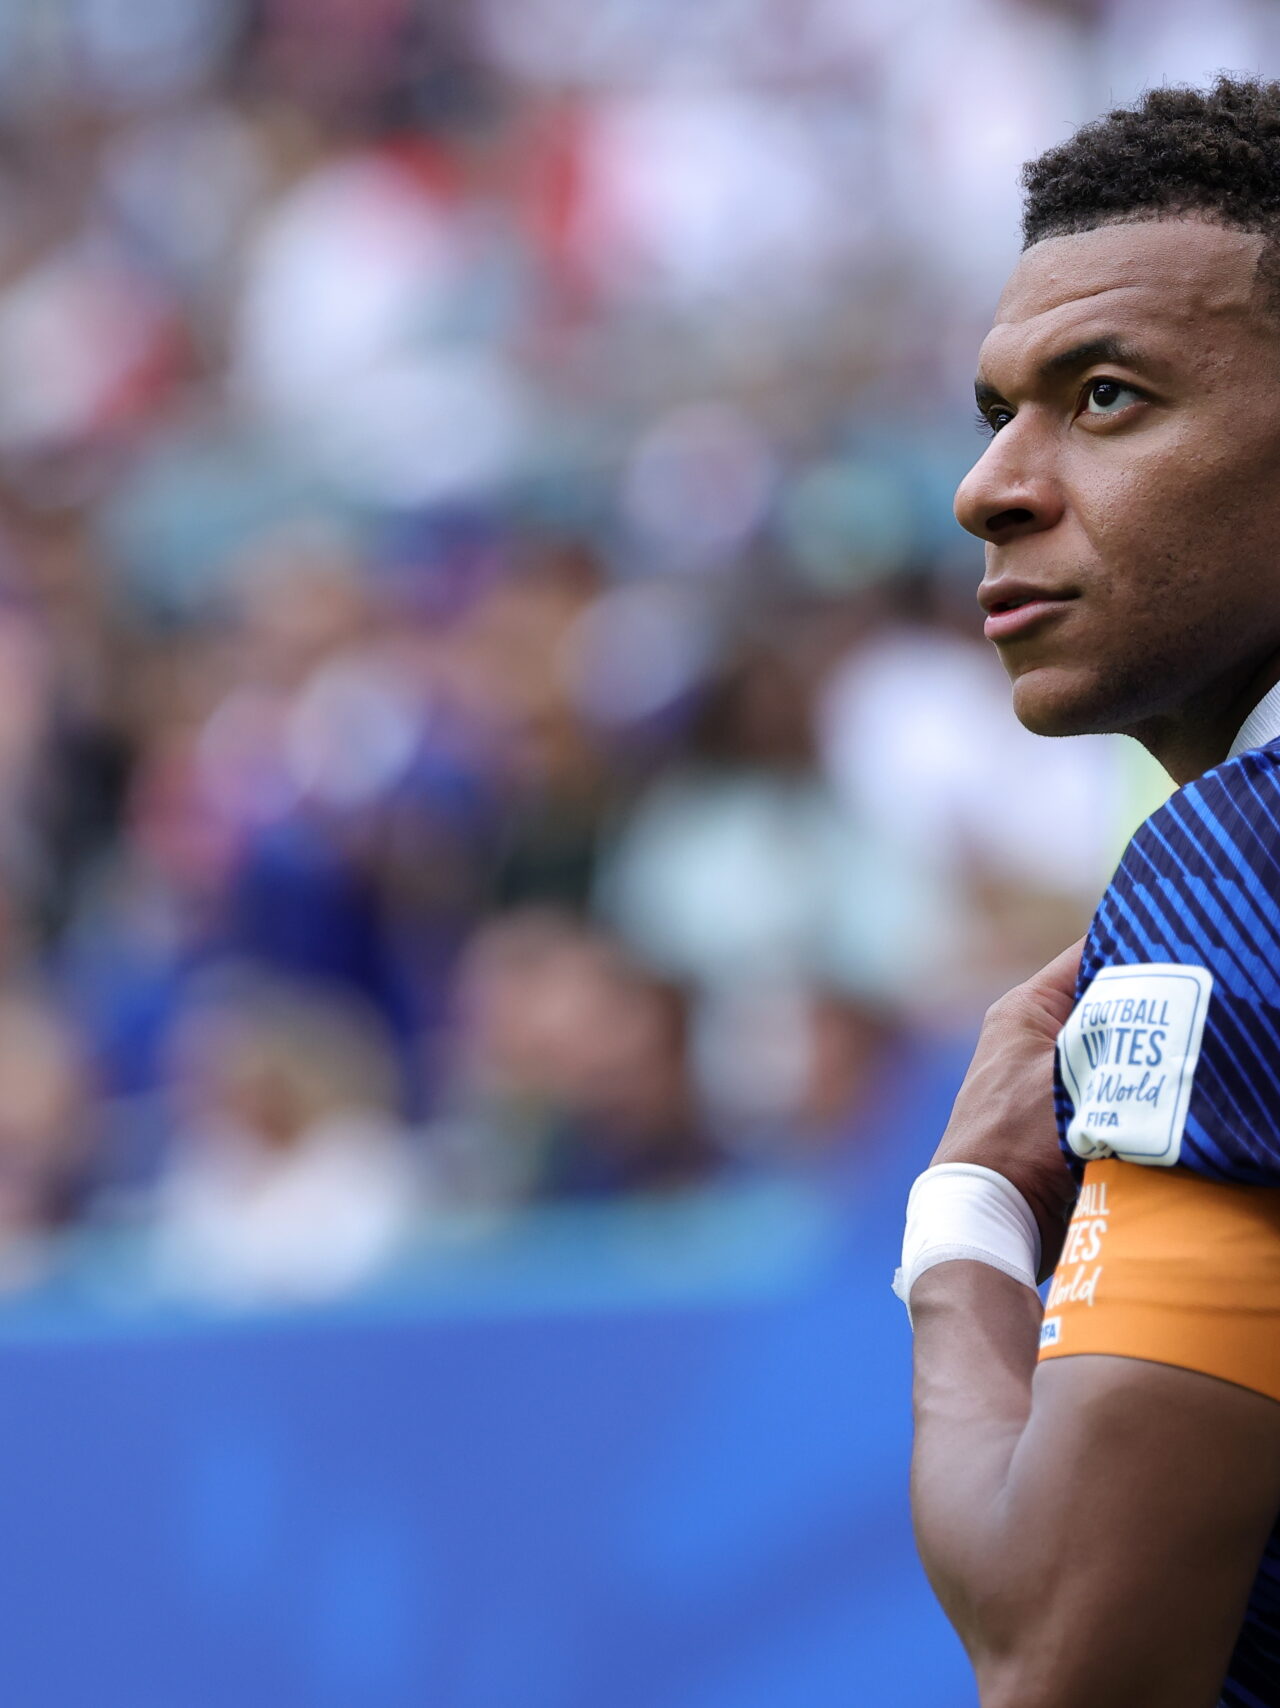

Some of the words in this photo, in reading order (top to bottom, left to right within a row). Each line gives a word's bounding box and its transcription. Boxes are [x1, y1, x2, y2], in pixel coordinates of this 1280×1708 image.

[1080, 999, 1170, 1029] FOOTBALL
[1097, 1071, 1166, 1108] World
[1086, 1112, 1119, 1127] FIFA
